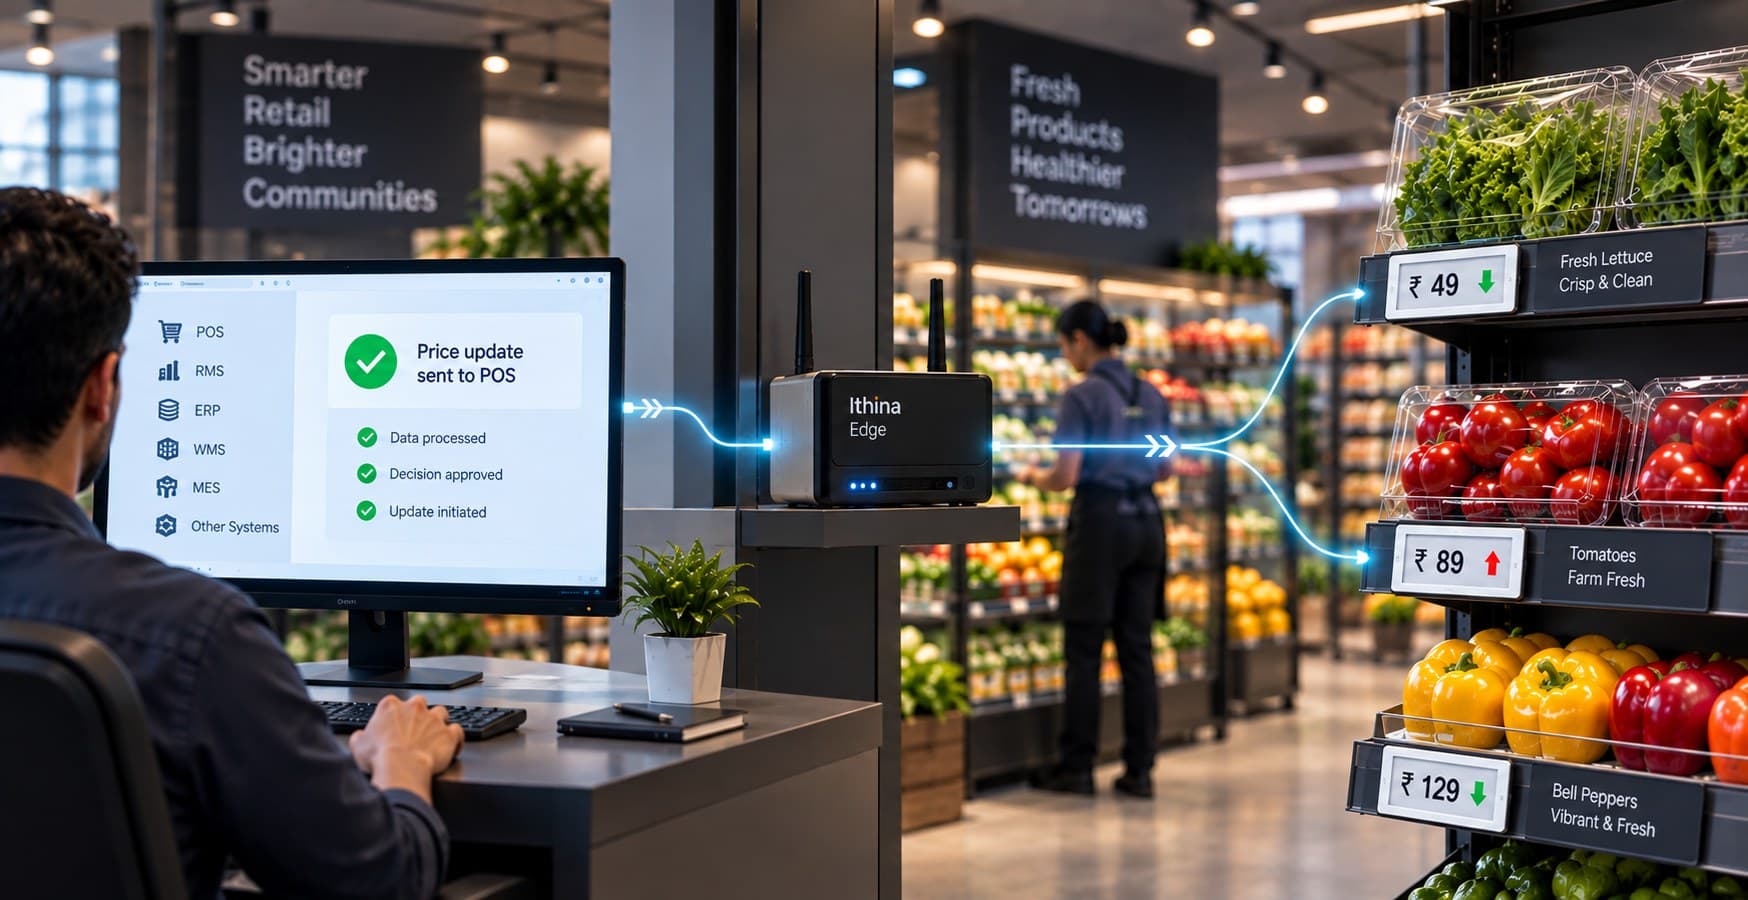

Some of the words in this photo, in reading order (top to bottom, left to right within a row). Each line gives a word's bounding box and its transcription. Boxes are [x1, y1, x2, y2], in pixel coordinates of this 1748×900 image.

[243, 54, 368, 91] Smarter
[1011, 64, 1081, 107] Fresh
[244, 94, 331, 127] Retail
[1011, 104, 1124, 152] Products
[245, 135, 367, 173] Brighter
[1011, 145, 1125, 190] Healthier
[243, 177, 437, 213] Communities
[1010, 184, 1147, 229] Tomorrows
[1561, 253, 1597, 268] Fresh
[1602, 251, 1653, 265] Lettuce
[1410, 276, 1421, 298] ₹
[1431, 273, 1458, 296] 49
[1560, 277, 1594, 293] Crisp
[1599, 275, 1608, 289] &
[1613, 273, 1652, 288] Clean
[197, 326, 224, 338] POS
[418, 344, 459, 359] Price
[465, 343, 523, 362] update
[196, 365, 224, 376] RMS
[417, 368, 453, 383] sent
[458, 369, 475, 383] to
[481, 368, 515, 383] POS
[195, 405, 220, 416] ERP
[850, 396, 901, 415] Ithina
[391, 432, 418, 443] Data
[423, 432, 485, 446] processed
[851, 422, 886, 440] Edge
[194, 444, 225, 455] WMS
[390, 468, 441, 480] Decision
[446, 469, 502, 483] approved
[193, 482, 220, 493] MES
[390, 505, 434, 519] Update
[438, 506, 486, 518] initiated
[192, 520, 225, 532] Other
[229, 521, 279, 535] Systems
[1415, 549, 1427, 572] ₹
[1437, 550, 1463, 574] 89
[1570, 546, 1636, 562] Tomatoes
[1568, 570, 1602, 585] Farm
[1607, 572, 1644, 587] Fresh
[1402, 772, 1414, 796] ₹
[1423, 775, 1459, 802] 129
[1553, 783, 1578, 801] Bell
[1582, 787, 1637, 809] Peppers
[1551, 808, 1599, 829] Vibrant
[1603, 816, 1612, 831] &
[1618, 818, 1655, 837] Fresh
